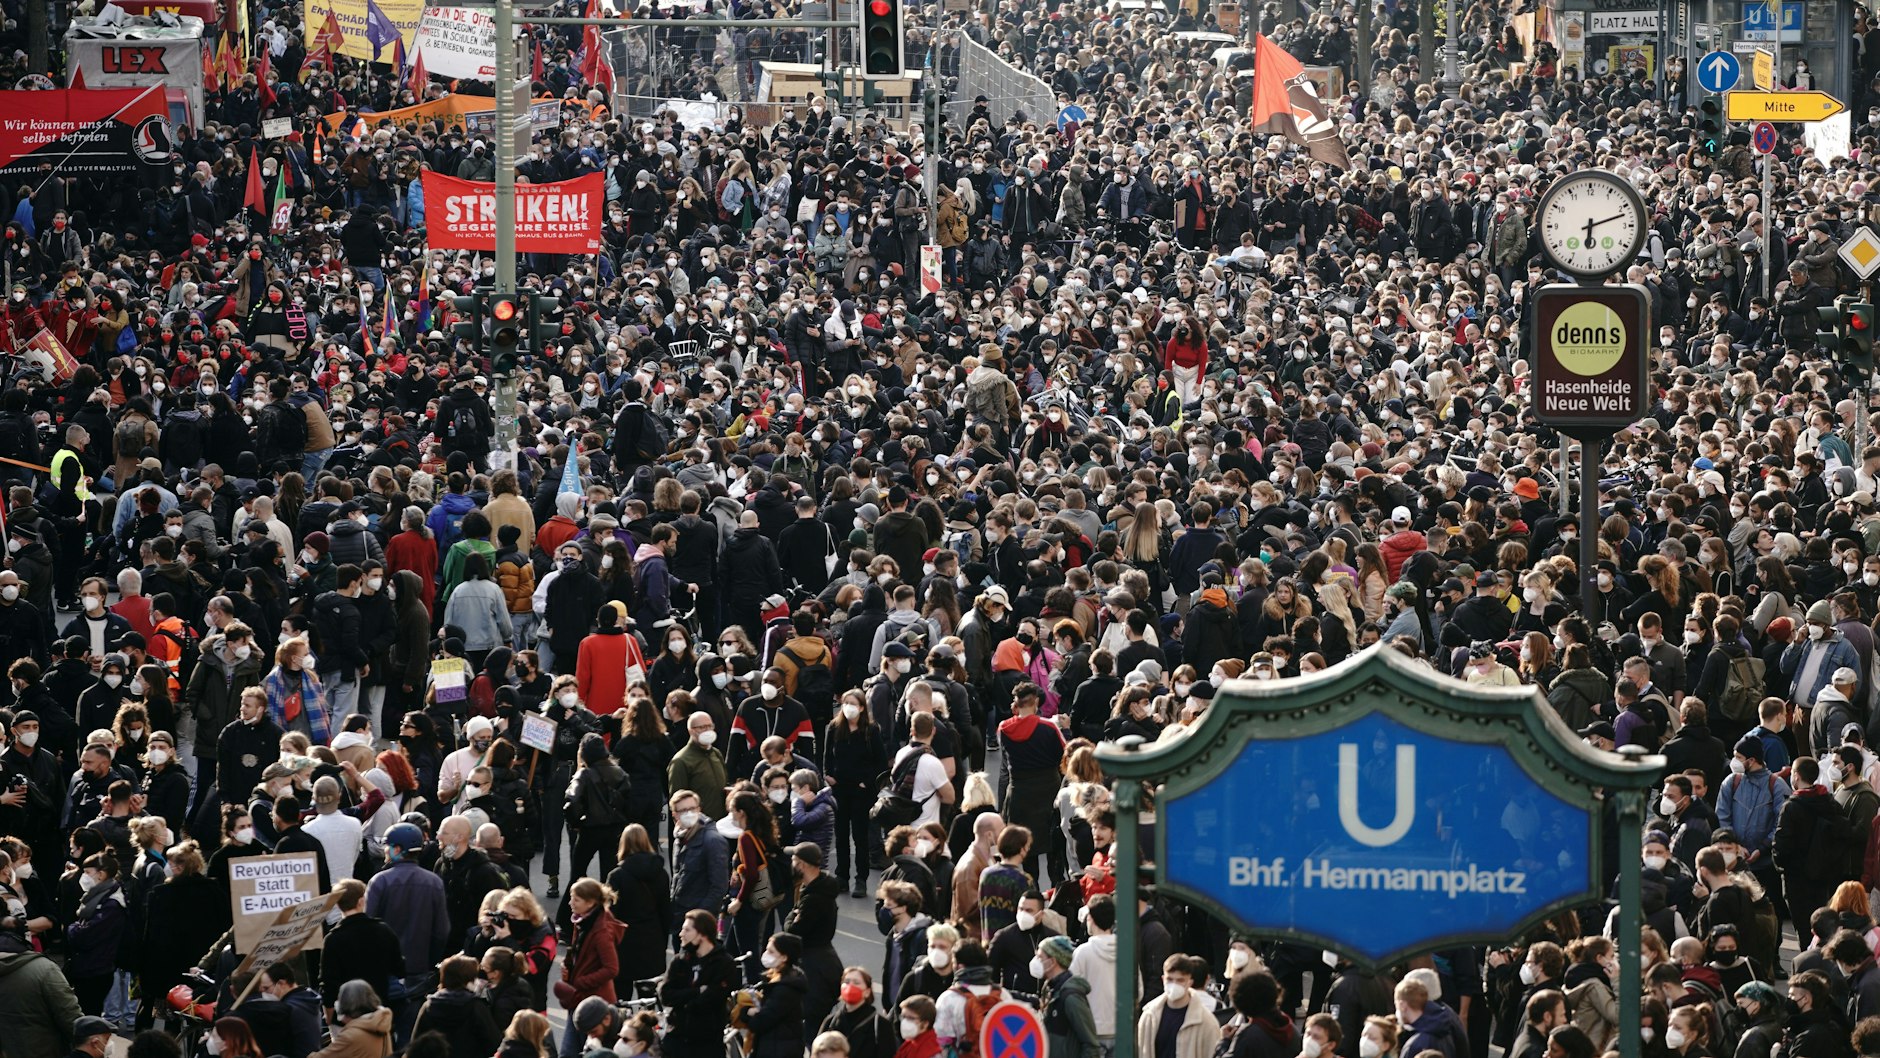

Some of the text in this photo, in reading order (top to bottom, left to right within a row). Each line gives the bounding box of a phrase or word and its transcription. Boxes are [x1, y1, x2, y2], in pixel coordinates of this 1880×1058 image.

[454, 9, 467, 22] DIE
[1749, 10, 1761, 24] U
[1593, 17, 1627, 29] PLATZ
[433, 39, 465, 53] BETRIEBEN
[102, 46, 169, 74] LEX
[1764, 102, 1796, 113] Mitte
[4, 119, 27, 131] Wir
[30, 119, 75, 130] können
[79, 121, 102, 131] uns
[22, 131, 109, 145] selbst befreien
[54, 165, 137, 173] SELBSTVERWALTUNG
[446, 193, 589, 223] STRIKEN!
[514, 223, 543, 232] HRE
[547, 222, 591, 232] KRISE.
[1558, 239, 1563, 247] 8
[1545, 379, 1632, 394] Hasenheide
[1545, 395, 1632, 411] Neue Welt
[1338, 743, 1416, 848] U
[235, 861, 312, 878] Revolution
[258, 878, 290, 892] statt
[1229, 857, 1527, 900] Bhf. Hermannplatz
[244, 894, 307, 911] E-Autos!
[293, 903, 324, 918] Keine
